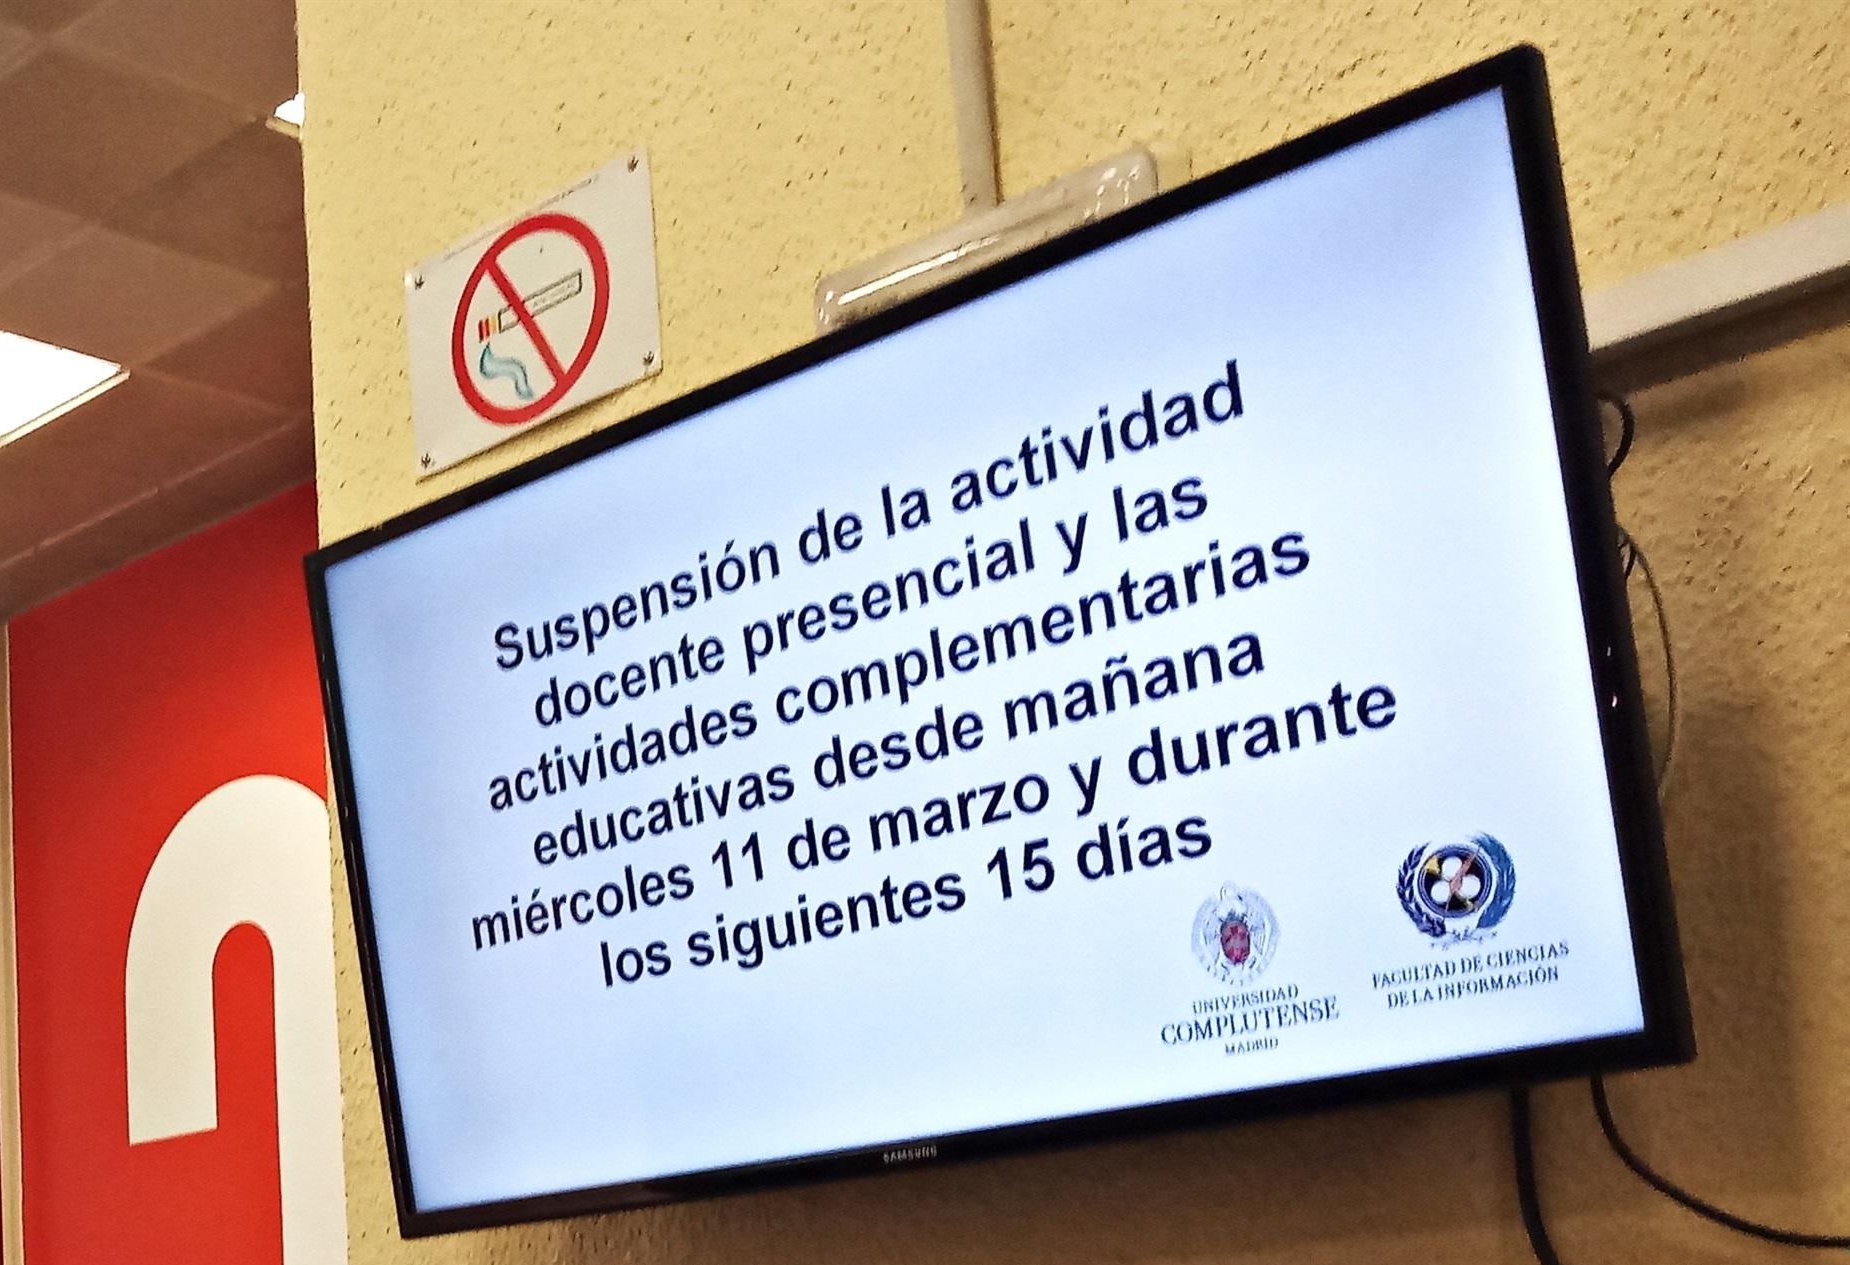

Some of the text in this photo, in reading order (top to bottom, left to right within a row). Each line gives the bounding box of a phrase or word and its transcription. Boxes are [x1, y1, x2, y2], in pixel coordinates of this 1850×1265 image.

[495, 359, 1244, 671] Suspensión de la actividad
[490, 533, 1310, 811] actividades complementarias
[536, 477, 1208, 727] docente presencial y las
[472, 685, 1396, 951] miércoles 11 de marzo y durante
[534, 634, 1265, 868] educativas desde mañana
[600, 817, 1212, 988] los siguientes 15 días
[1372, 941, 1570, 990] FACULTAD DE CIENCIAS
[1386, 965, 1559, 1011] DE LA INFORMACIÓN
[1161, 995, 1340, 1046] COMPLUTENSE
[1192, 984, 1299, 1016] UNIVERSIDAD
[883, 1144, 937, 1163] SAMSUNG
